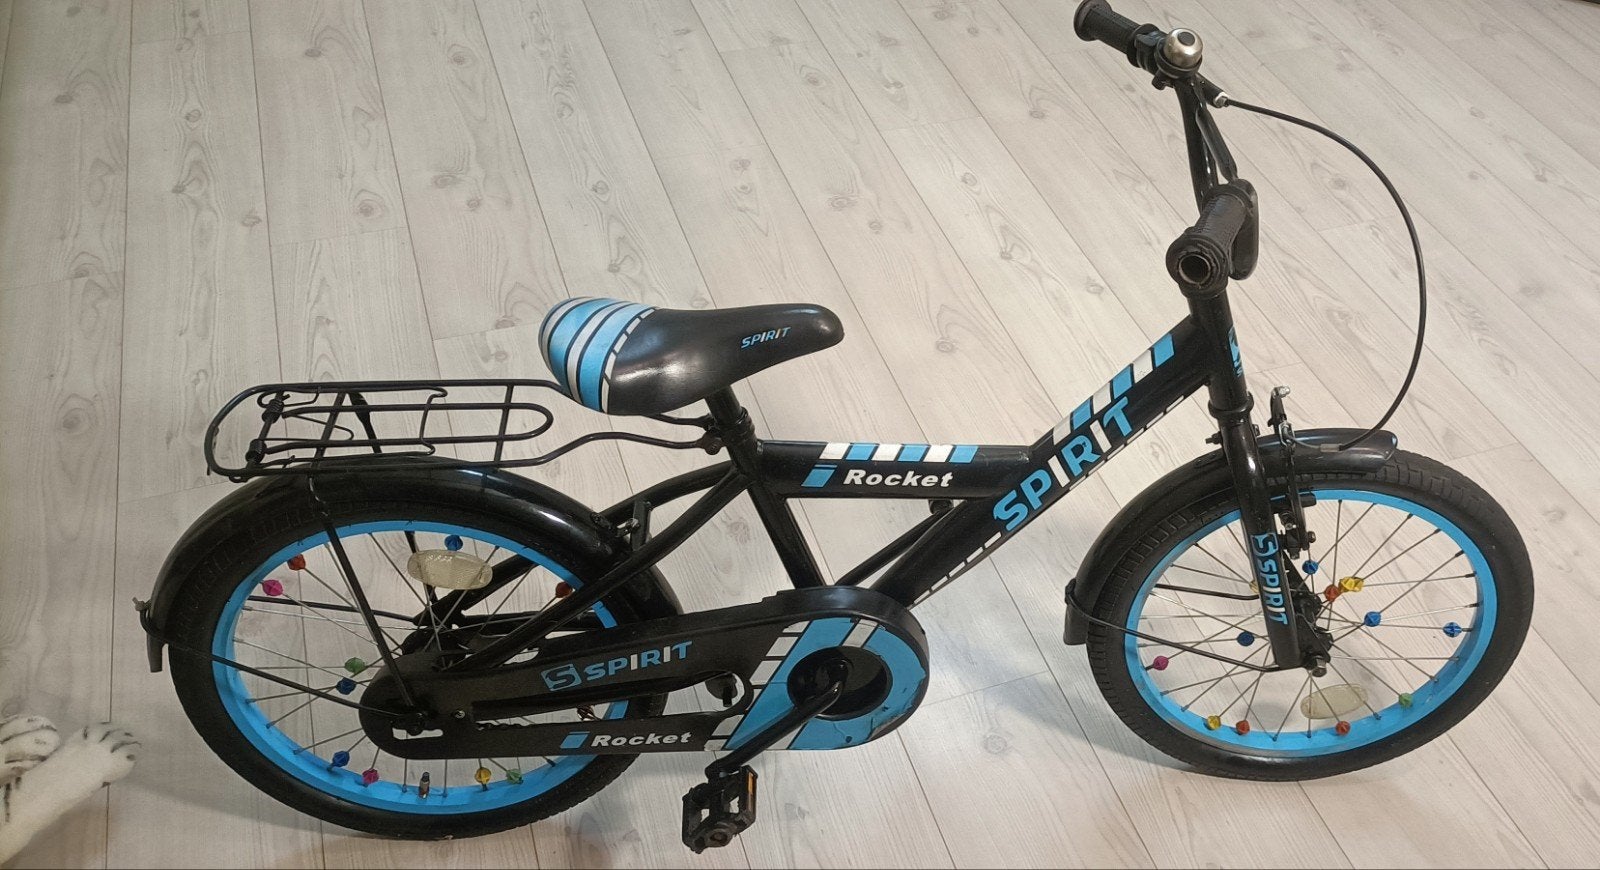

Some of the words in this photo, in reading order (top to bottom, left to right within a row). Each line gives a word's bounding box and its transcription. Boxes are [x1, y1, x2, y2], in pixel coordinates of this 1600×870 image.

[740, 326, 791, 349] SPIRIT
[843, 469, 953, 487] Rocket
[993, 396, 1133, 532] SPIRIT
[1257, 559, 1288, 625] SPIRIT
[583, 641, 693, 681] SPIRIT
[591, 731, 692, 747] Rocket
